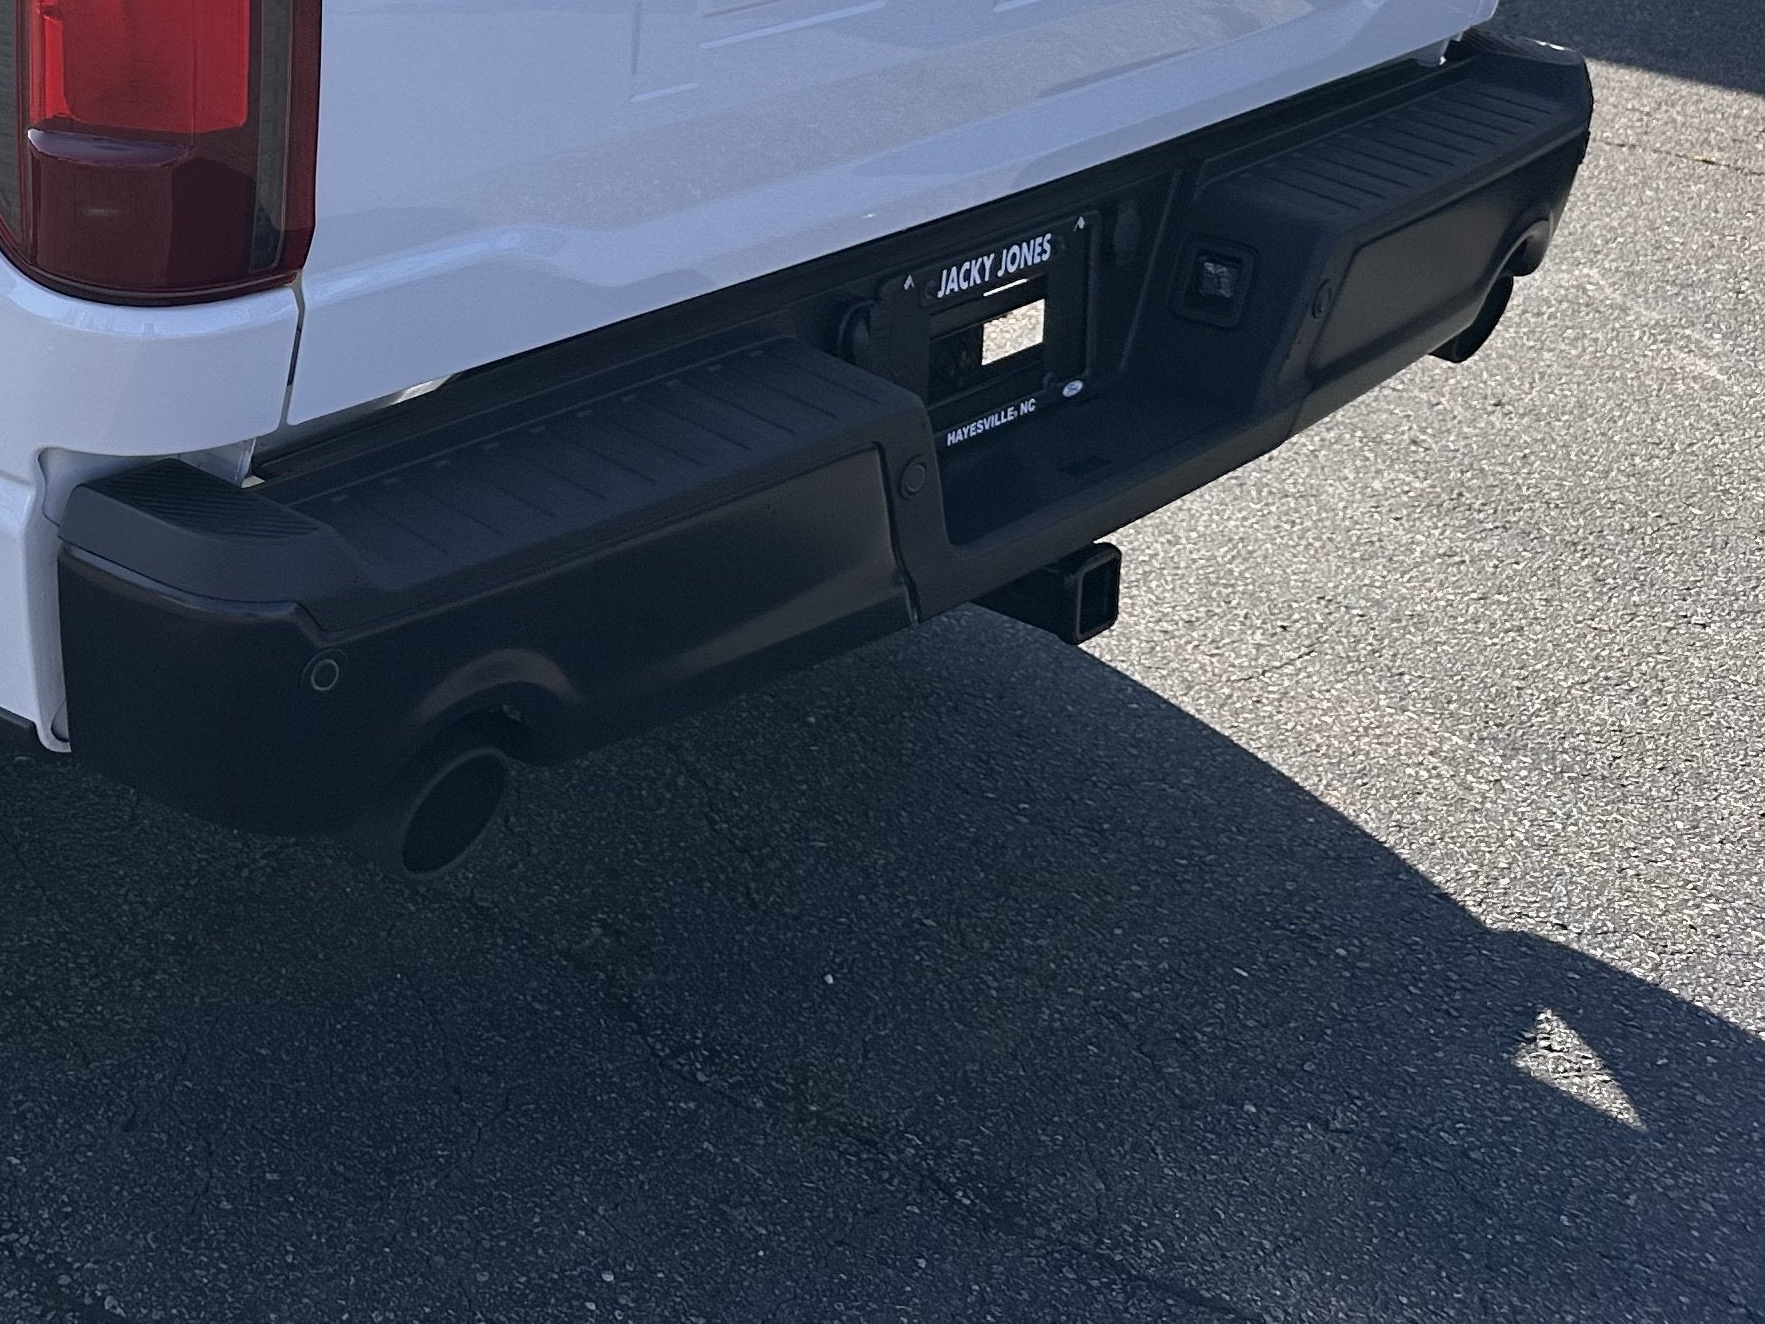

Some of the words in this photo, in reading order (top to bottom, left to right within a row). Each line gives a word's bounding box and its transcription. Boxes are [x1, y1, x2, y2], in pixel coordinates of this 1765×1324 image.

[936, 252, 996, 299] JACKY
[996, 232, 1053, 278] JONES
[946, 406, 1018, 447] HAYESVILLE,
[1019, 397, 1037, 417] NC
